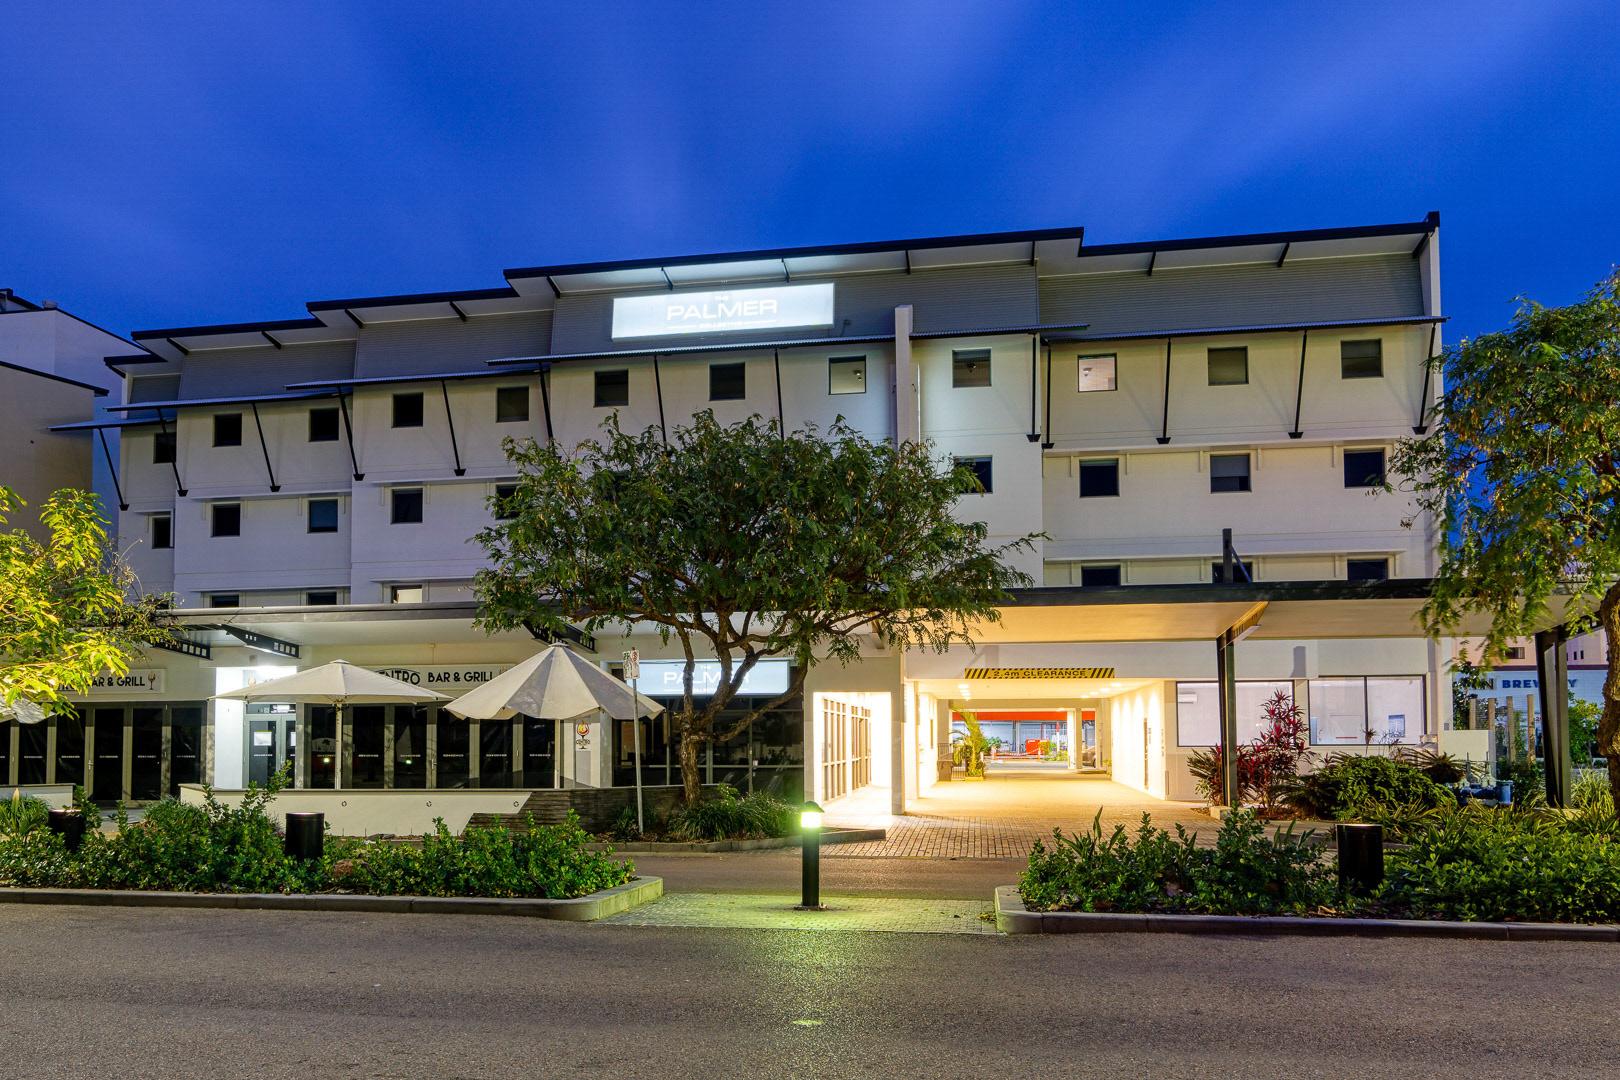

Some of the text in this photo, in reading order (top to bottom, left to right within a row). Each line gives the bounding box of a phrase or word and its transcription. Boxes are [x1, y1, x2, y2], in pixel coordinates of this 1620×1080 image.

[666, 299, 777, 320] PALMER
[87, 676, 105, 687] AR
[107, 677, 114, 687] &
[116, 676, 146, 687] GRILL
[379, 670, 421, 685] NTRO
[427, 672, 451, 683] BAR
[453, 671, 462, 682] &
[1502, 679, 1578, 688] BREY
